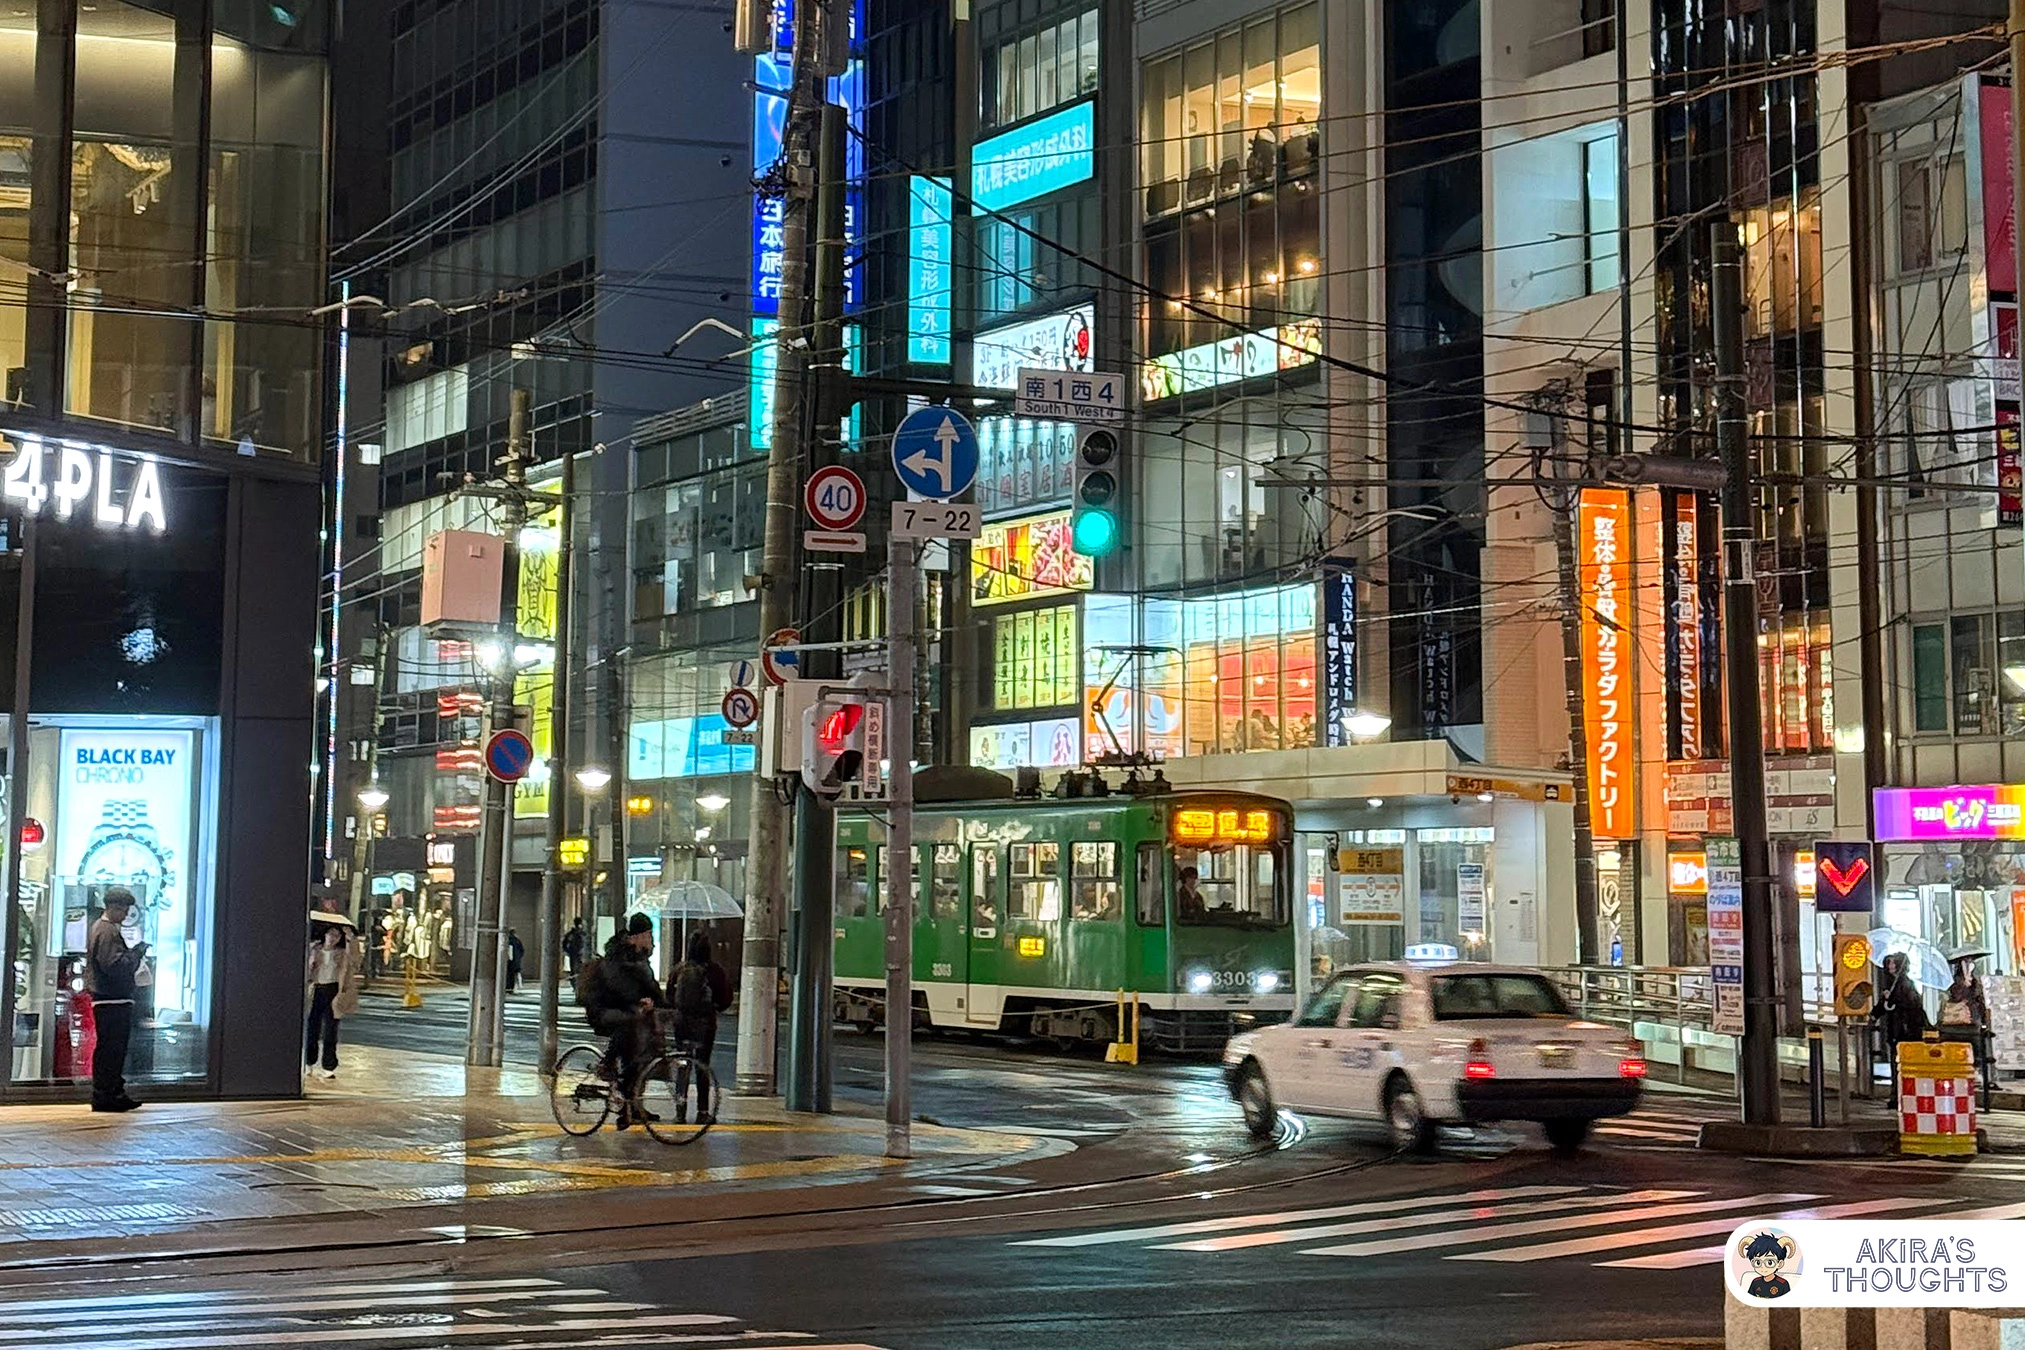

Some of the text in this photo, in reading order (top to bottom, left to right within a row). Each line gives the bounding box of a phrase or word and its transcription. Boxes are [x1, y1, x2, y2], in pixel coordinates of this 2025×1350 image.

[759, 198, 783, 298] 日本旅行
[1025, 376, 1114, 403] 南1西4
[4, 441, 166, 529] 4PLA
[820, 485, 852, 512] 40
[76, 748, 176, 765] BLACK BAY
[1212, 971, 1257, 986] 3303
